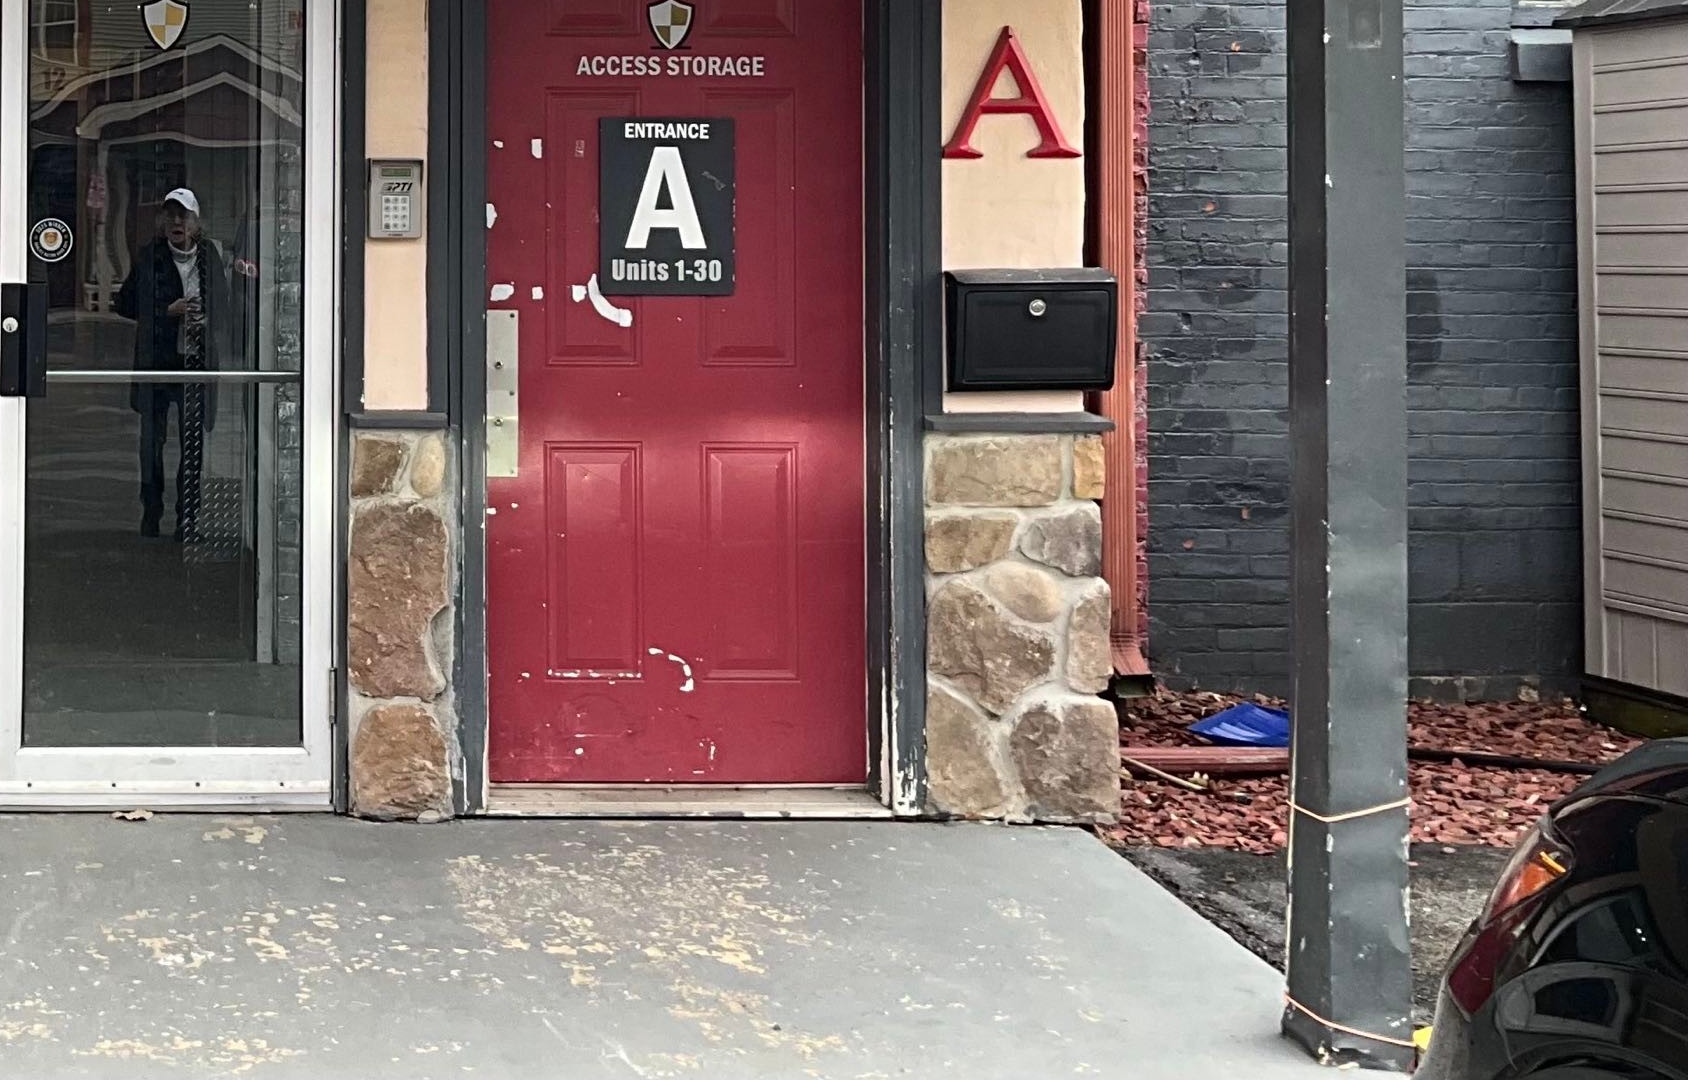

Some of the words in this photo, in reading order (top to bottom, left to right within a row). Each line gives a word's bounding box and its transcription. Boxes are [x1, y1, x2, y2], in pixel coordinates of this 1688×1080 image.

[576, 55, 661, 76] ACCESS
[666, 56, 765, 76] STORAGE
[942, 25, 1083, 159] A
[624, 122, 710, 139] ENTRANCE
[624, 146, 707, 249] A
[612, 258, 669, 282] Units
[675, 259, 722, 282] 1-30
